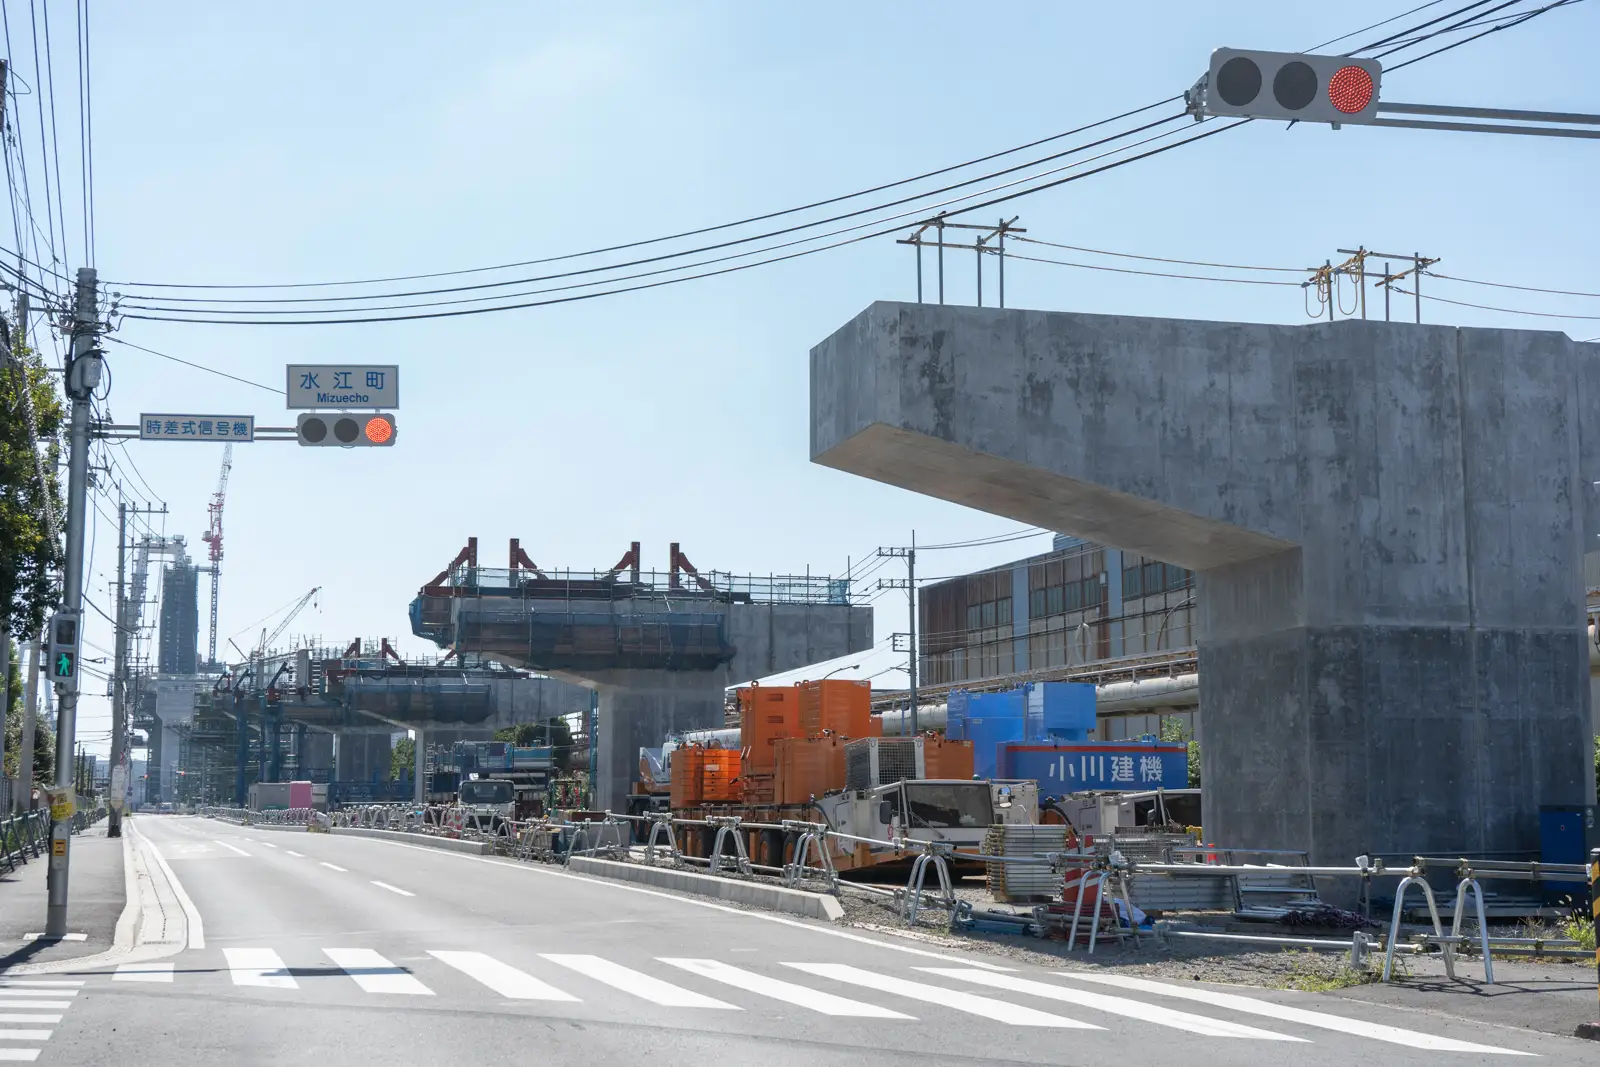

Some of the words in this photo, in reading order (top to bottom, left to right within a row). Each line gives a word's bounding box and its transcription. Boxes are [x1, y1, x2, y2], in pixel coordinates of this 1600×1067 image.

[300, 372, 385, 389] 水江町
[316, 392, 369, 403] Mizuecho
[146, 419, 248, 437] 時差式信号機
[1049, 756, 1163, 782] 小川建機
